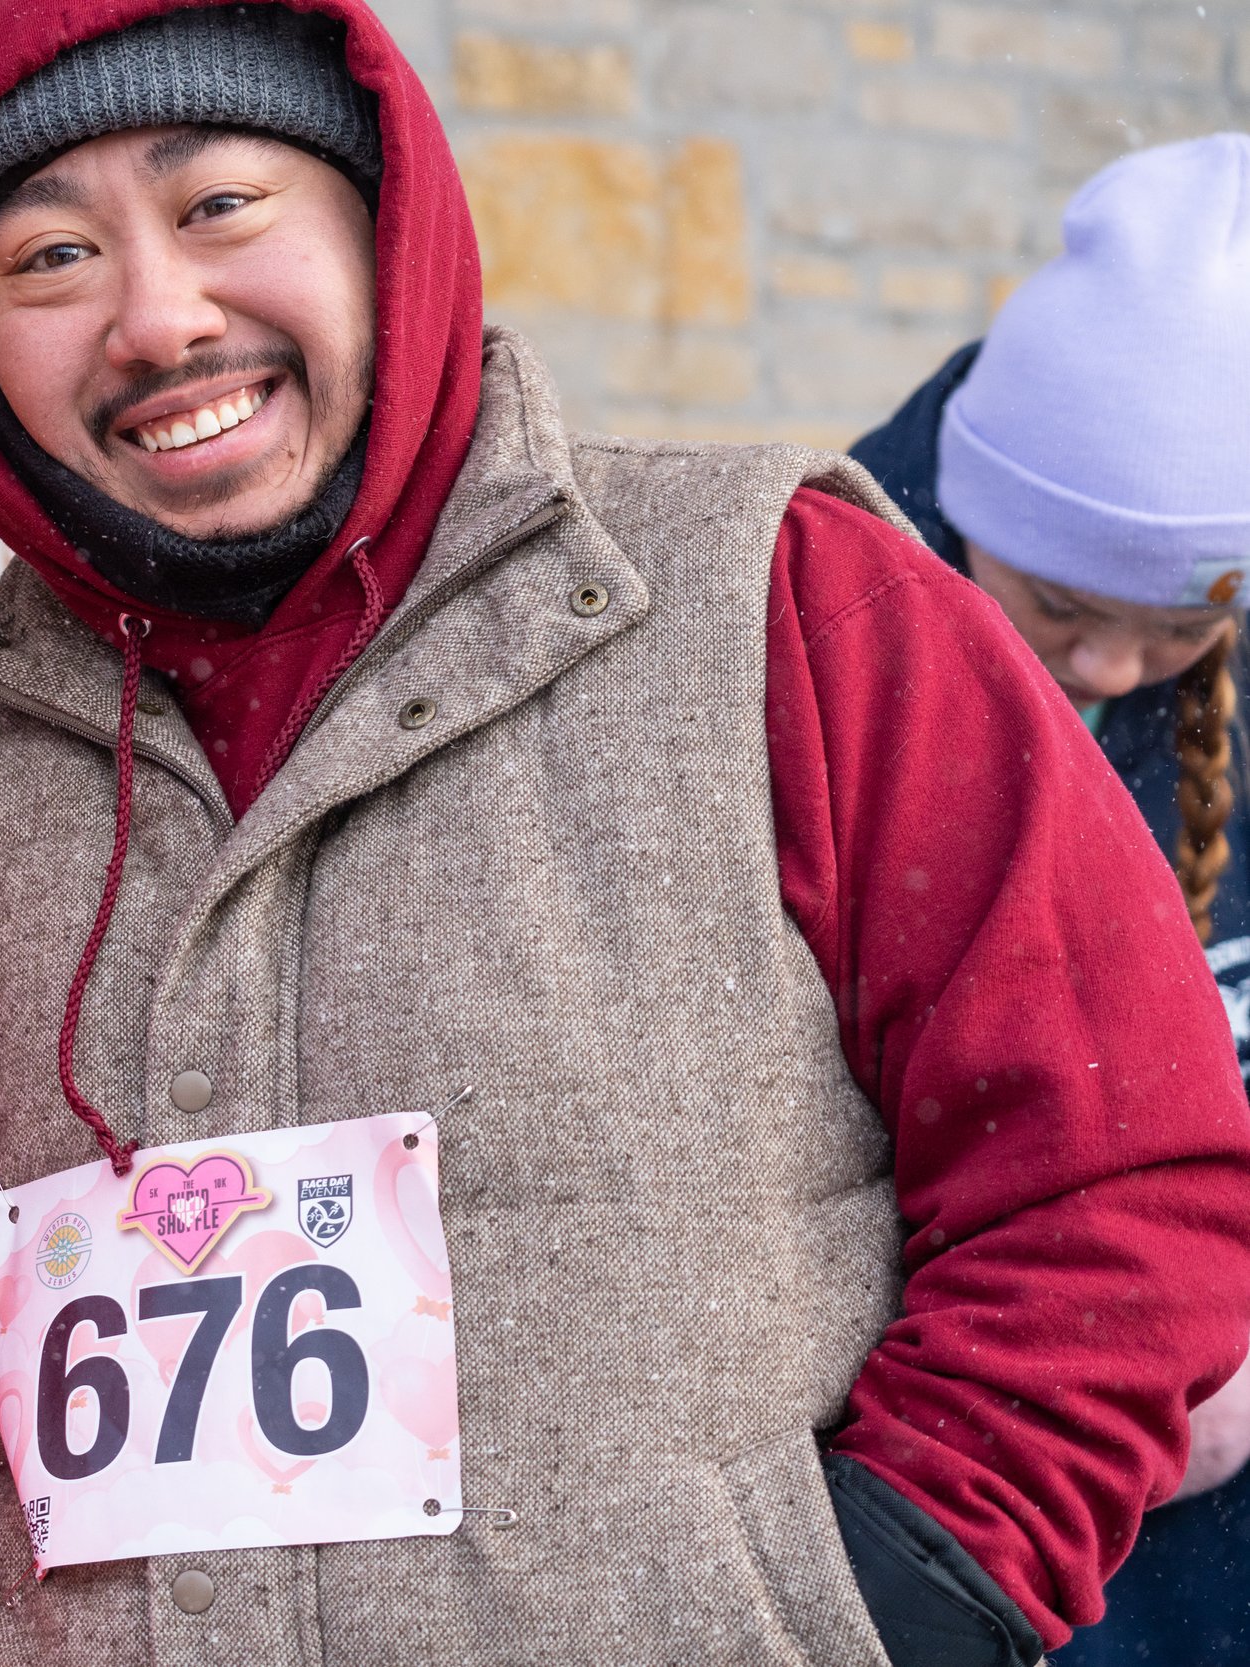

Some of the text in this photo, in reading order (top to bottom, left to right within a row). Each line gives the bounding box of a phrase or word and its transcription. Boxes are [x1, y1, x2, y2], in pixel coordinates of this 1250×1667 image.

[182, 1180, 195, 1190] THE
[302, 1175, 350, 1189] RACE DAY
[149, 1188, 159, 1199] 5K
[300, 1185, 349, 1198] EVENTS
[167, 1188, 209, 1214] CUPID
[157, 1208, 219, 1236] SHUFFLE
[37, 1263, 369, 1481] 676
